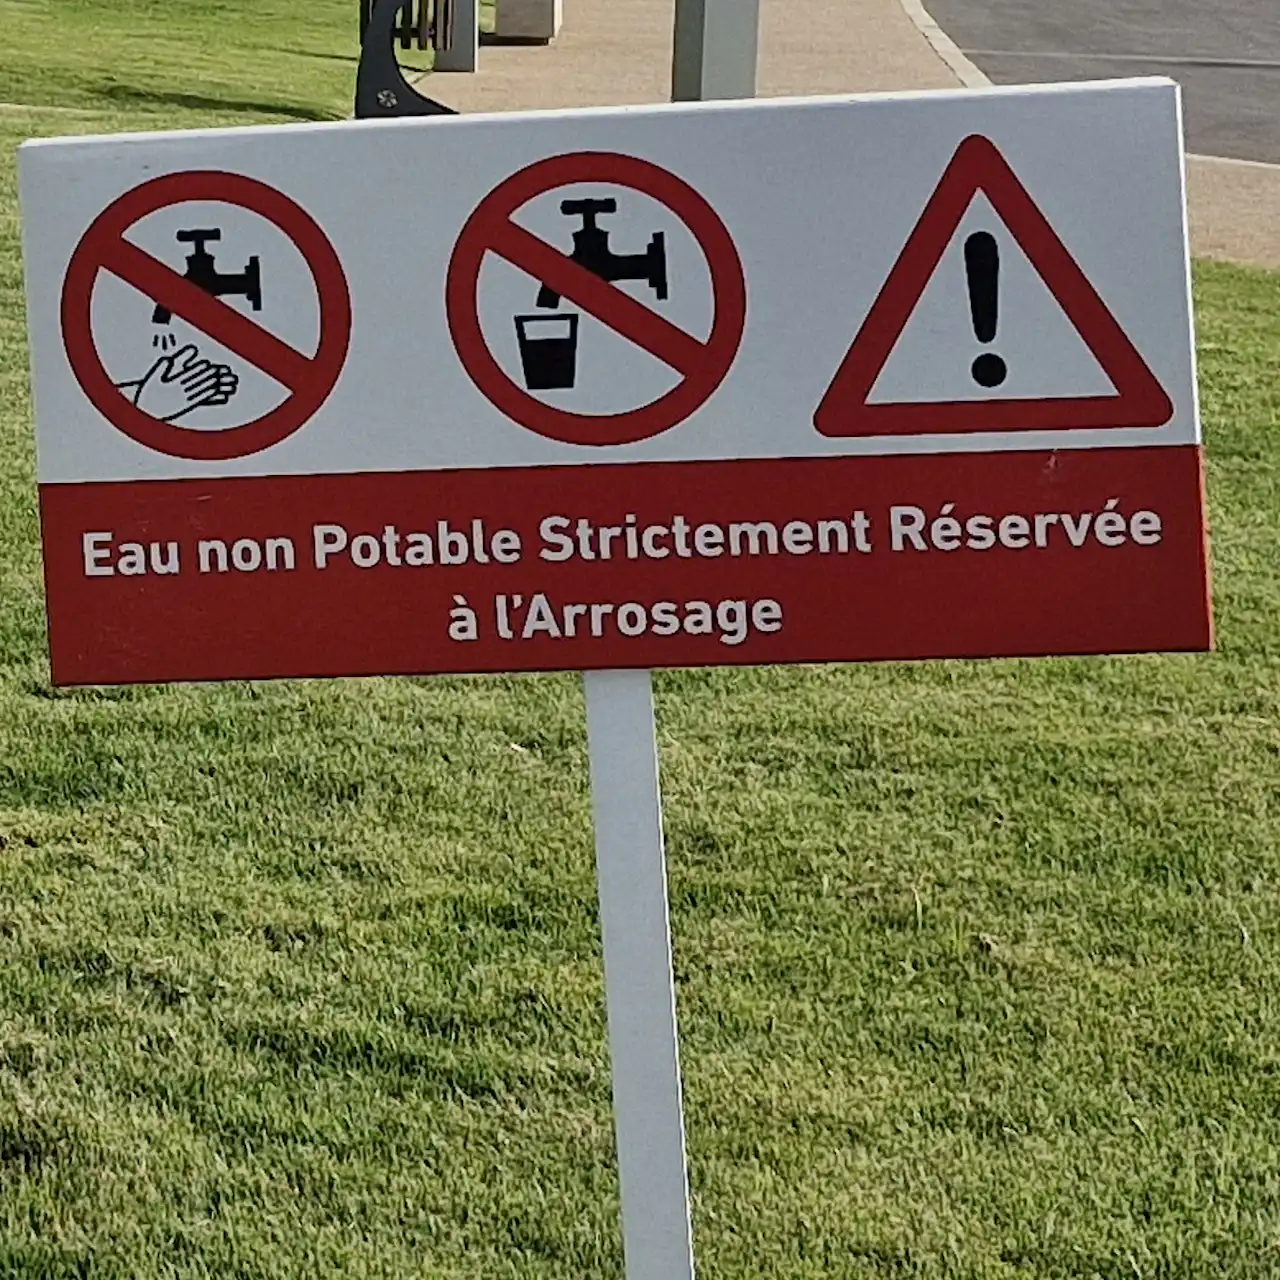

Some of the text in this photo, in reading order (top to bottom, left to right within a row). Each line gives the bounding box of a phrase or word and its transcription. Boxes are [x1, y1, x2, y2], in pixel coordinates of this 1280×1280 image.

[82, 498, 1162, 576] Eau non Potable Strictement Réservée
[448, 593, 783, 645] à l'Arrosage
